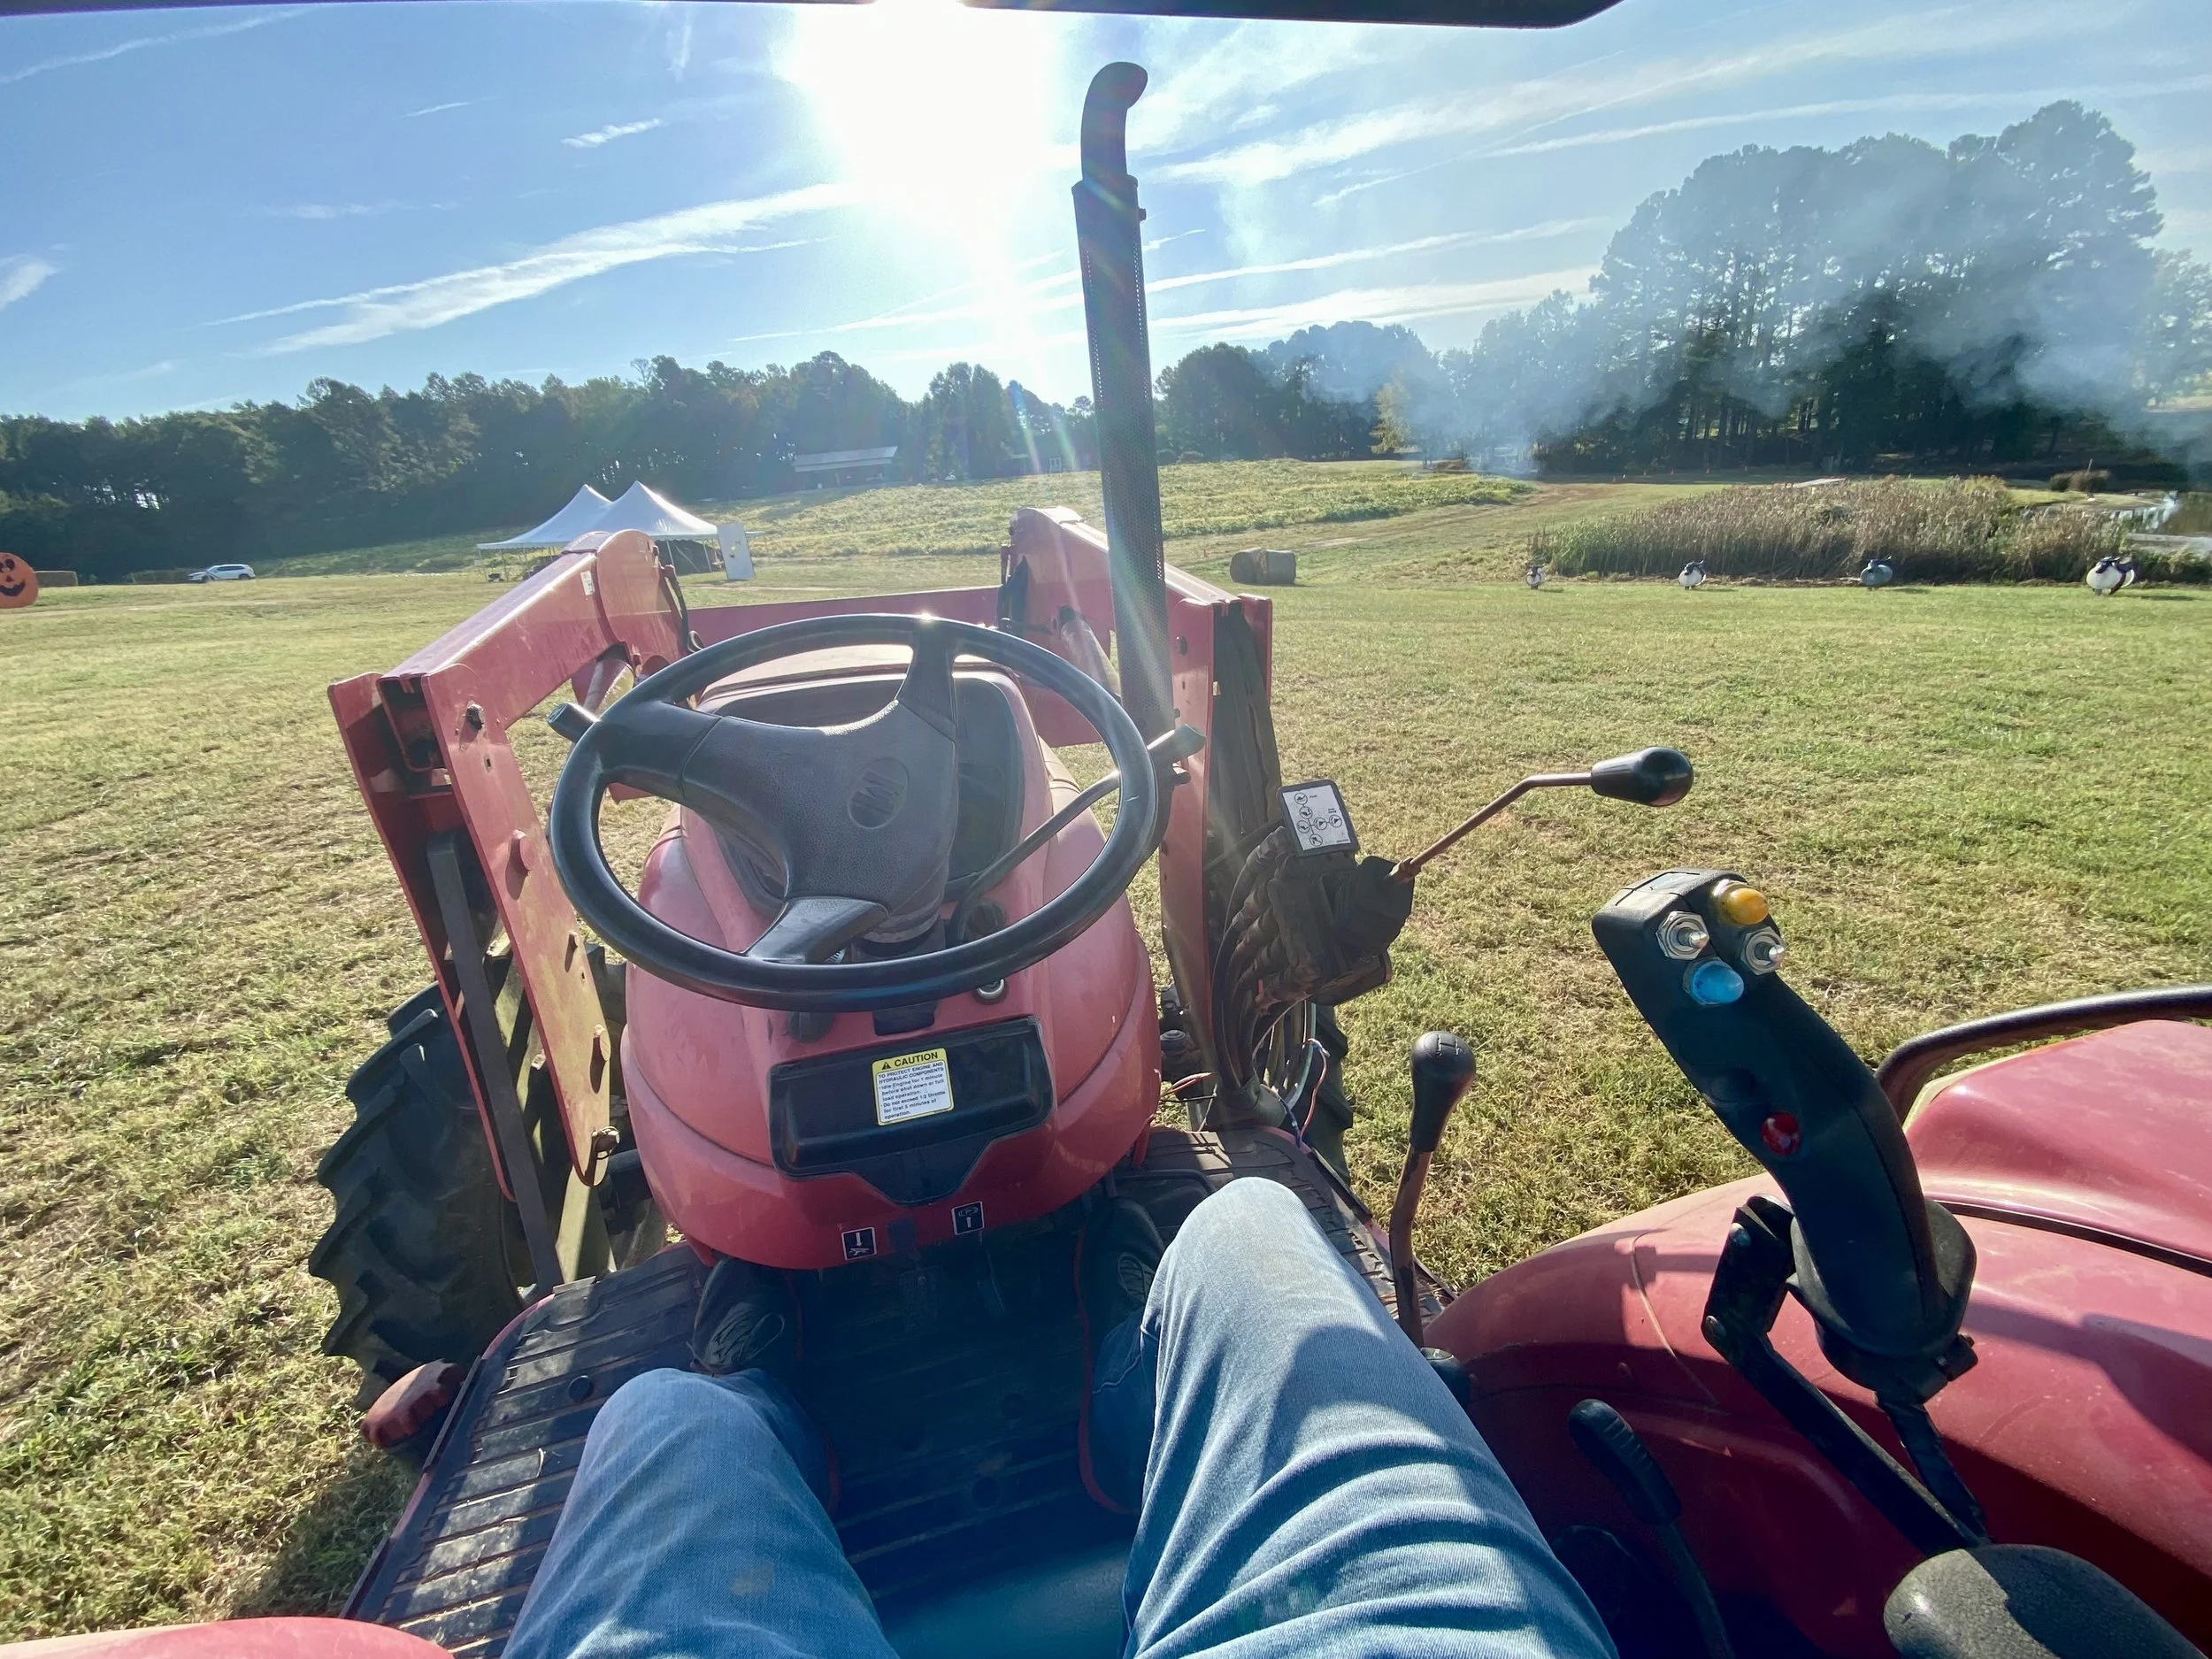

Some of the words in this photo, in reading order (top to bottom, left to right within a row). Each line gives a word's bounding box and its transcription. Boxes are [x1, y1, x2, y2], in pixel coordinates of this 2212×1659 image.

[895, 1052, 938, 1066] CAUTION
[879, 1075, 908, 1084] HYDRAULIC
[909, 1067, 944, 1077] COMPONENTS
